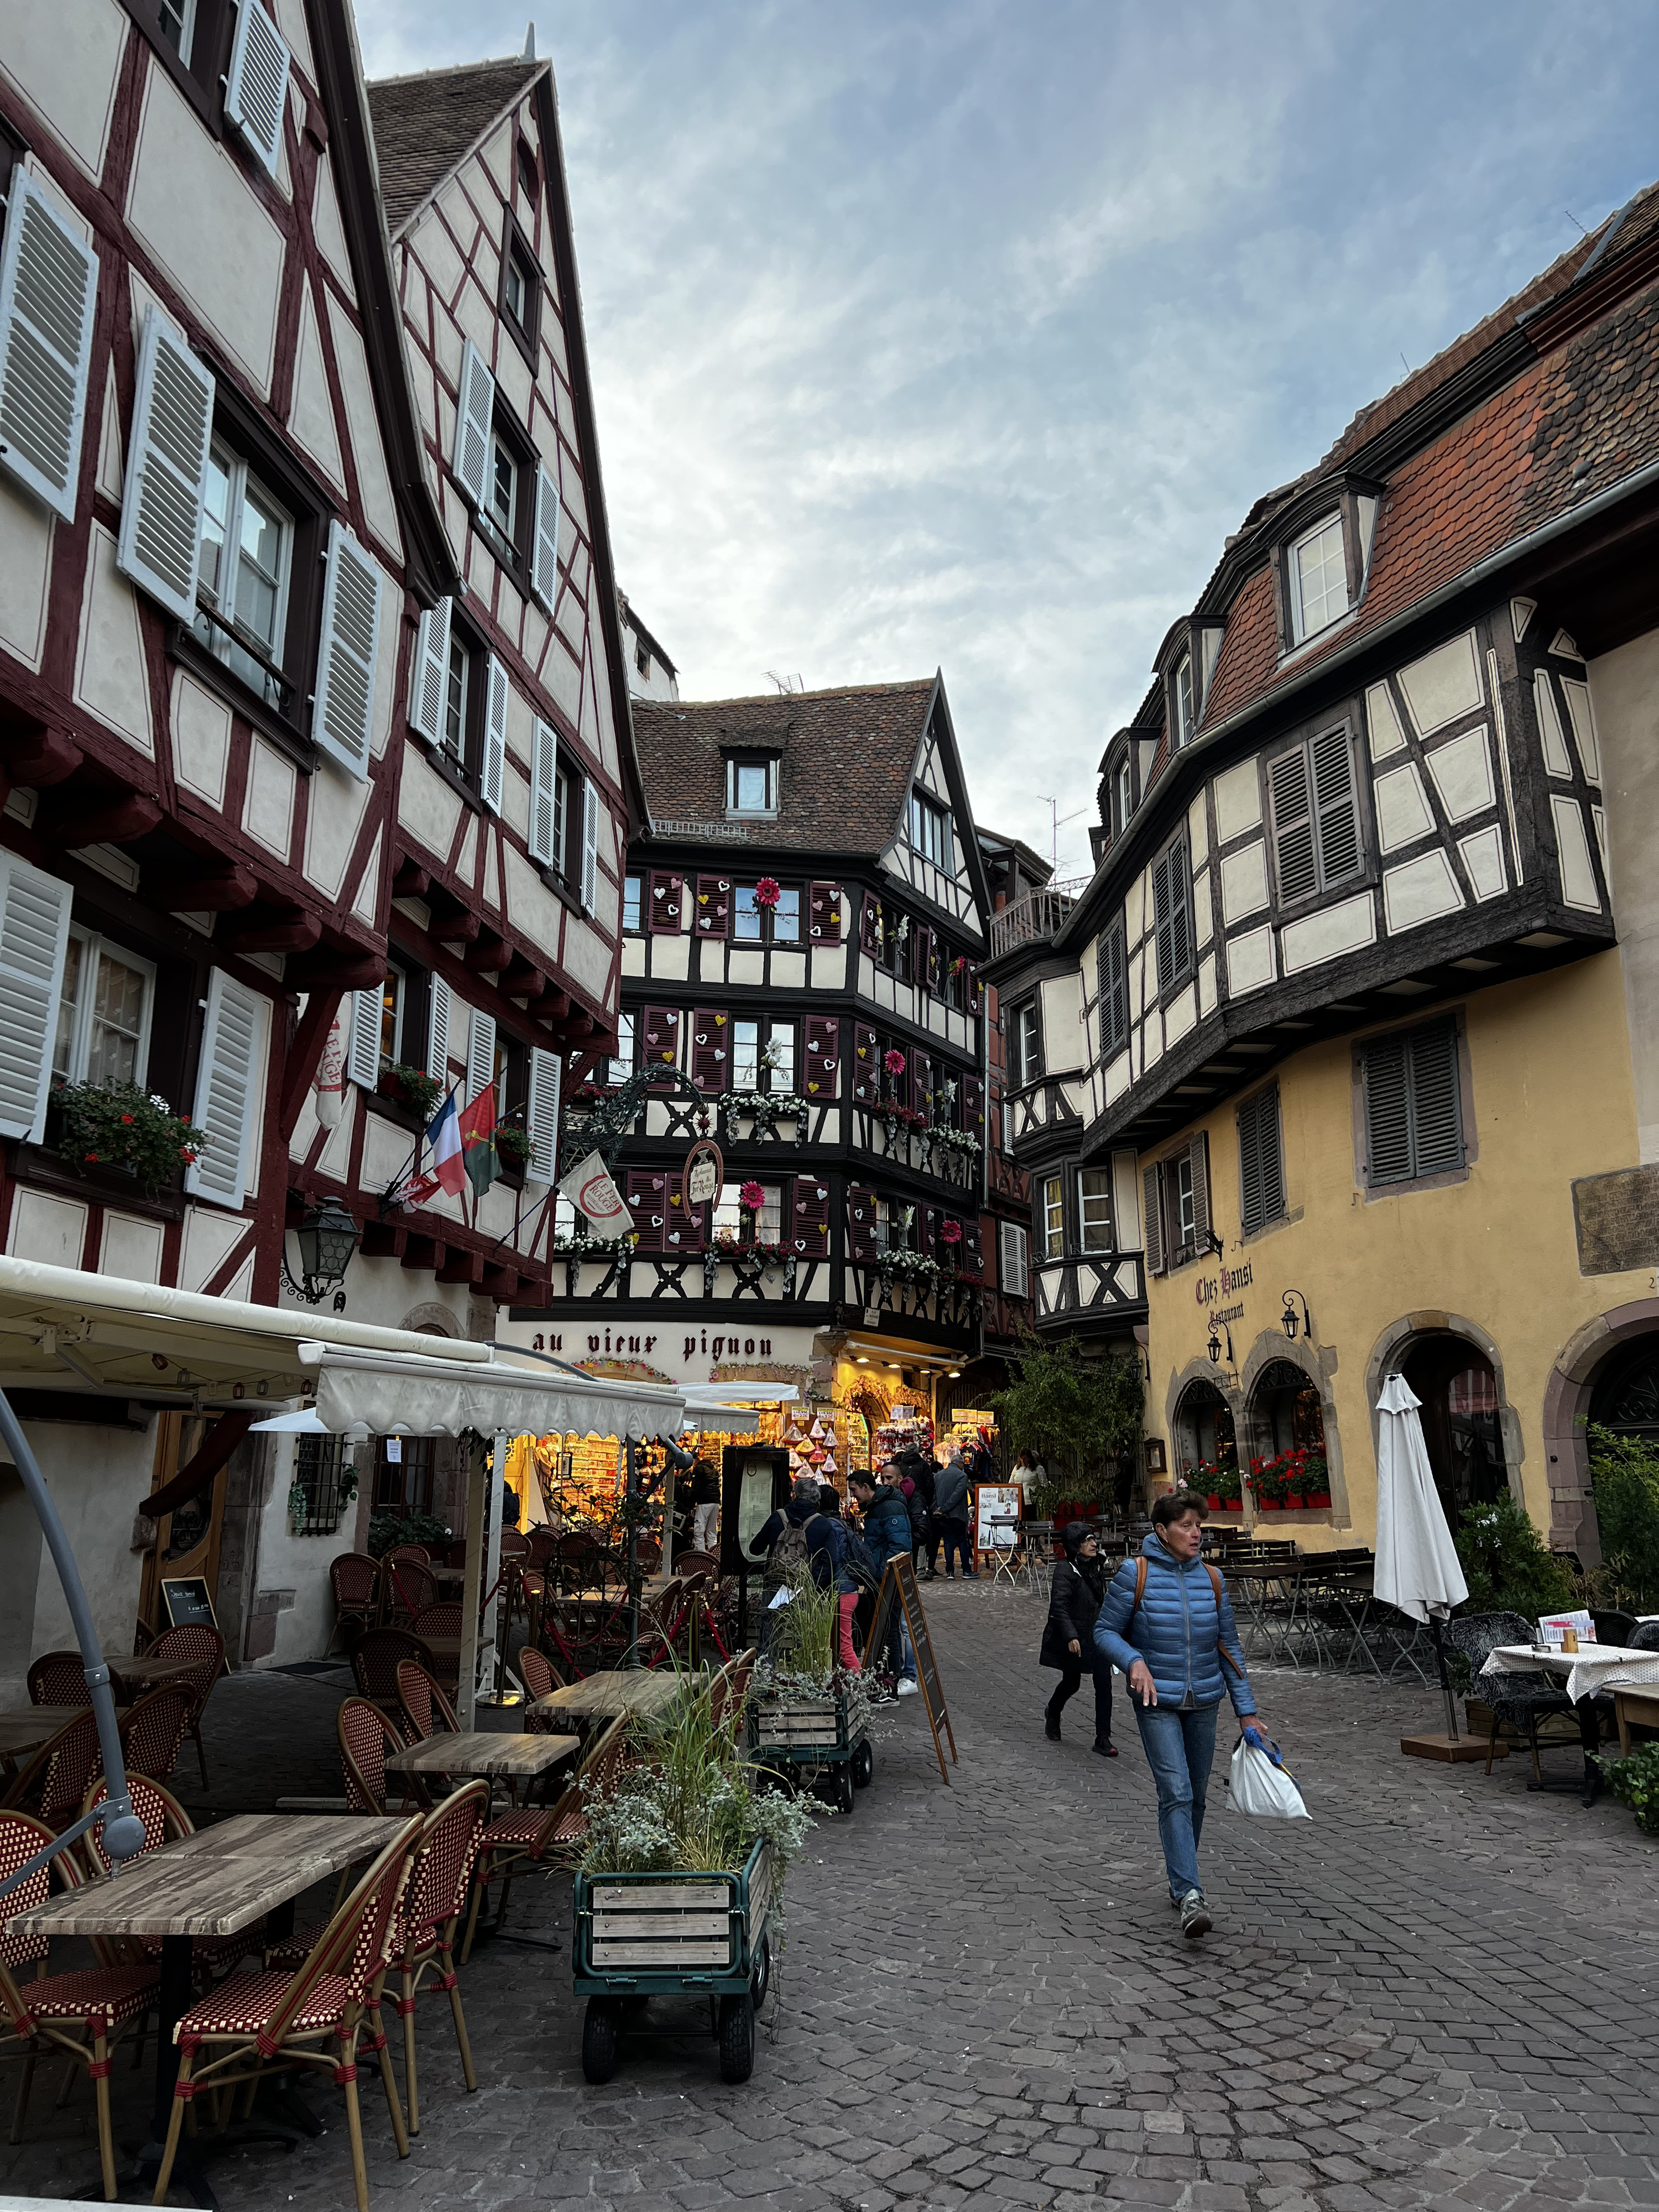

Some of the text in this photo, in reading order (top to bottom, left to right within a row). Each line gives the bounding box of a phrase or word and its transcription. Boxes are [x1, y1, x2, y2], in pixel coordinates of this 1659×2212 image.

[589, 1185, 615, 1212] ROUGE
[597, 1180, 620, 1207] LE FER
[1196, 1257, 1254, 1307] Chez Hansi
[1209, 1301, 1244, 1328] Restaurant
[533, 1327, 773, 1363] au vieux pignon
